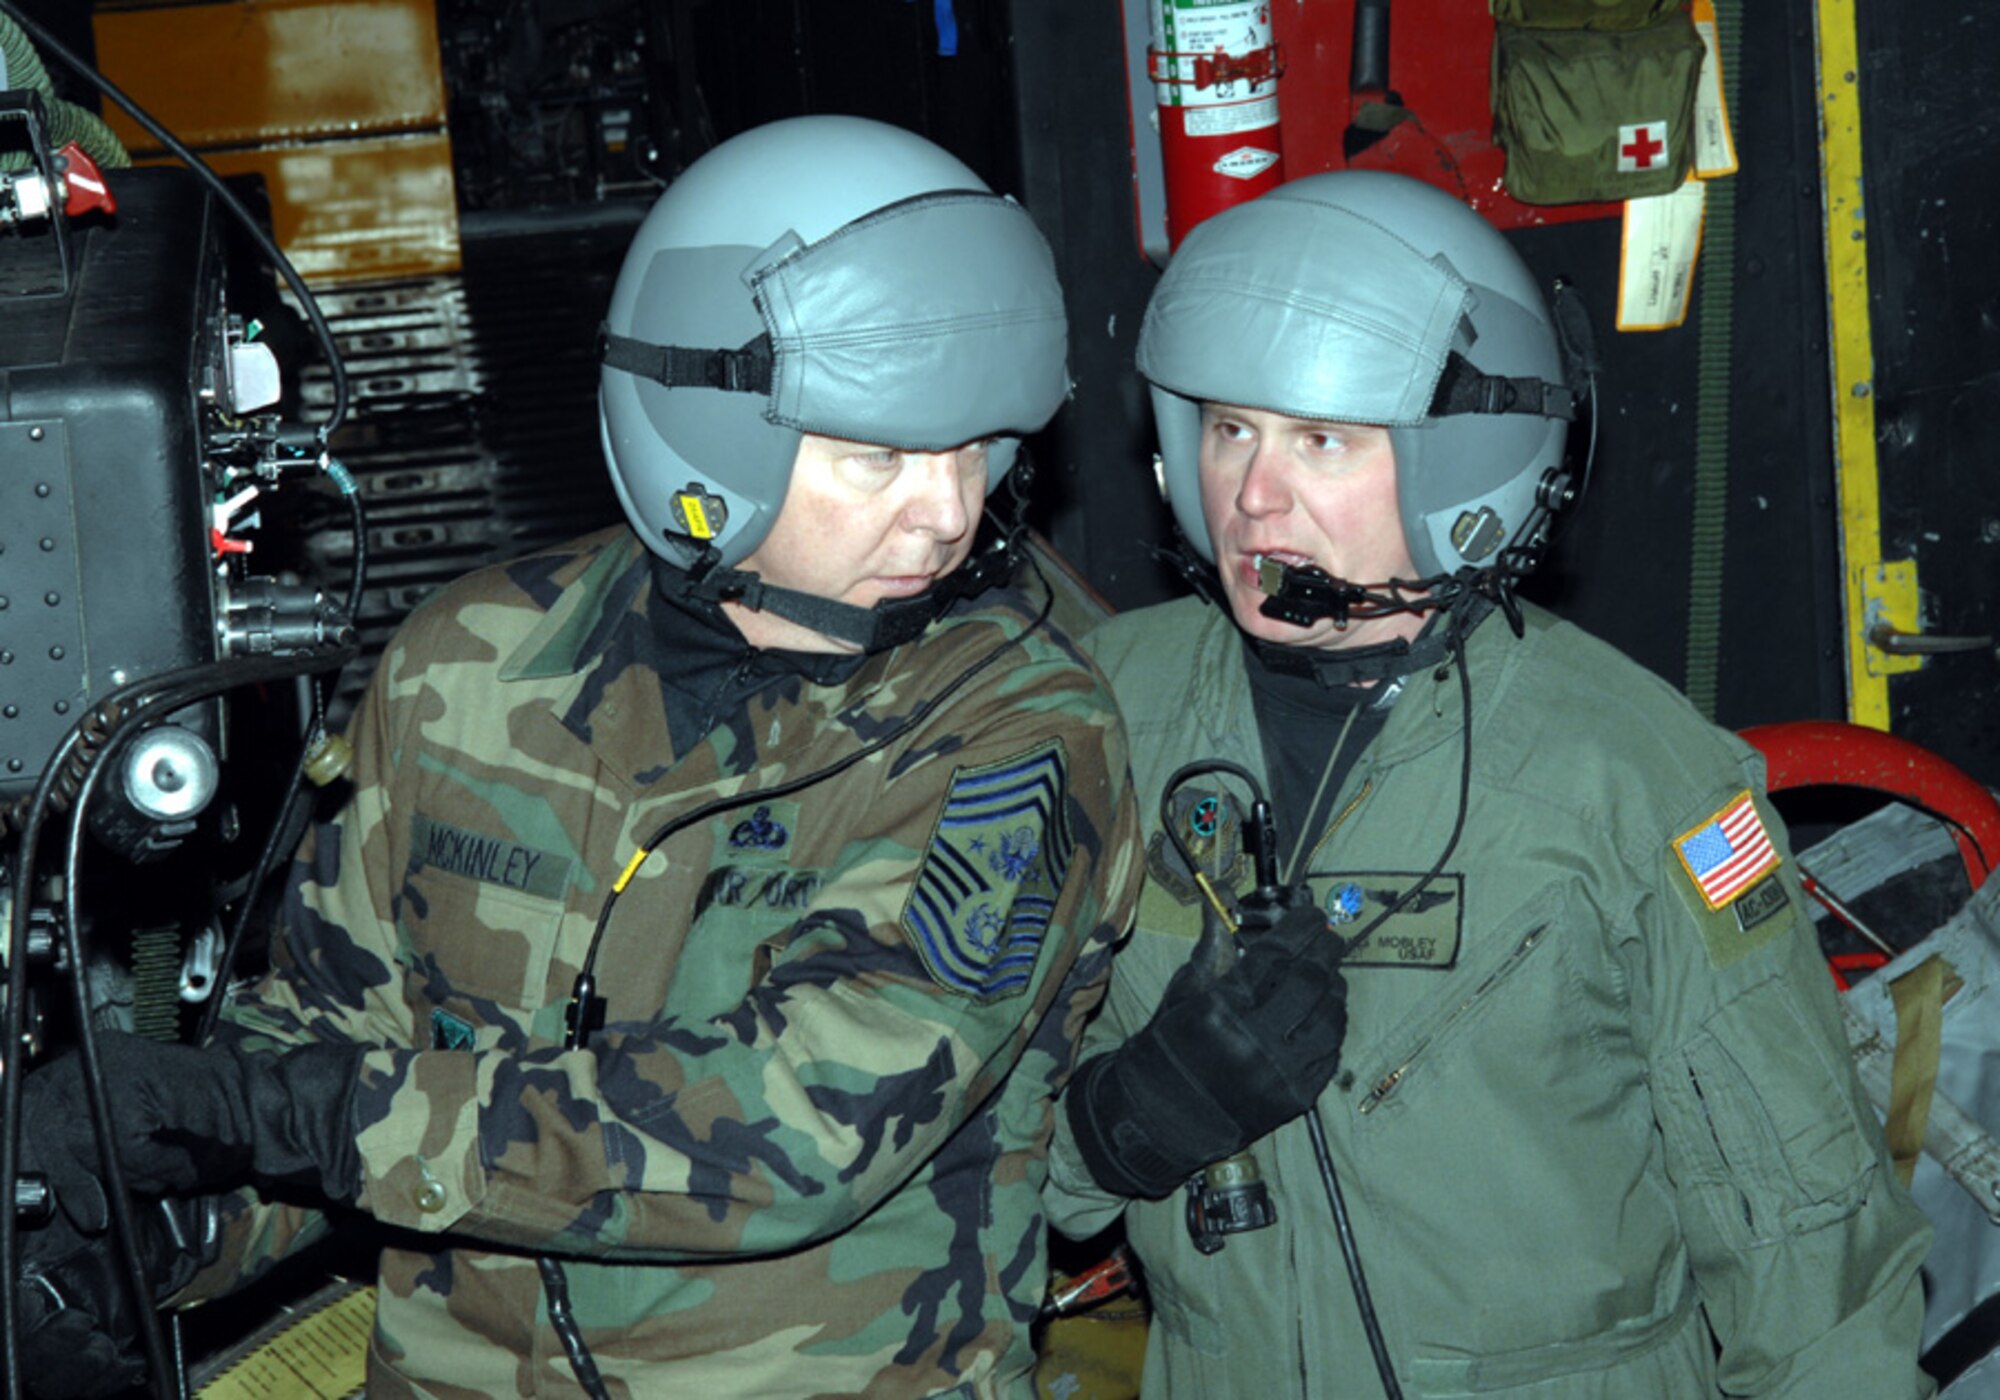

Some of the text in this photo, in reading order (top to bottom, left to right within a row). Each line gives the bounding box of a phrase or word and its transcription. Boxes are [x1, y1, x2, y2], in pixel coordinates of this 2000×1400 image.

[427, 828, 541, 890] MCKINLEY
[1378, 936, 1436, 949] MOBLEY
[1398, 947, 1436, 960] USAF
